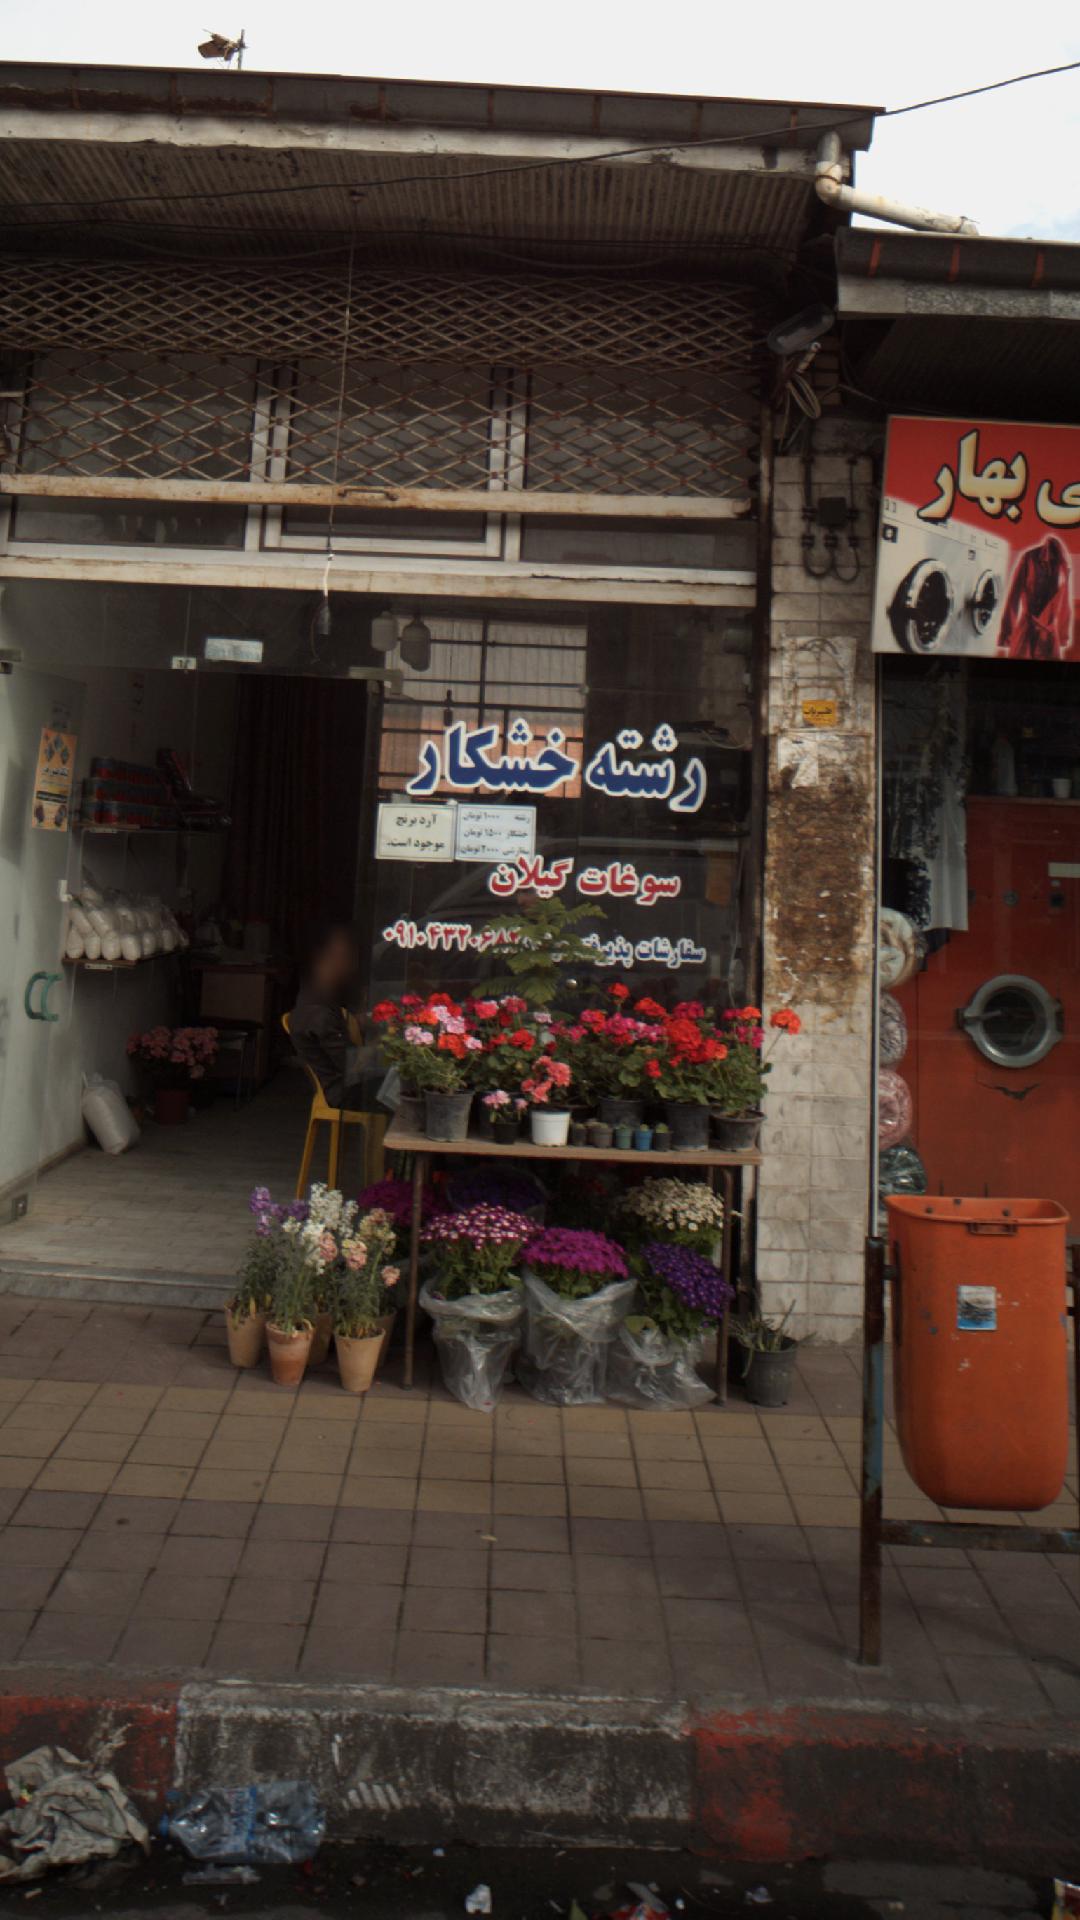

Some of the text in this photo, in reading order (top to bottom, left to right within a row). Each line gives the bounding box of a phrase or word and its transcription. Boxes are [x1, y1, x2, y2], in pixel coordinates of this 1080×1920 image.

[917, 428, 1029, 523] بهار
[407, 718, 706, 812] رشته خشکار
[395, 812, 437, 829] آرد برنج
[414, 839, 445, 851] موجود
[488, 856, 680, 905] سوغات گیلان
[635, 936, 706, 968] سفارشات
